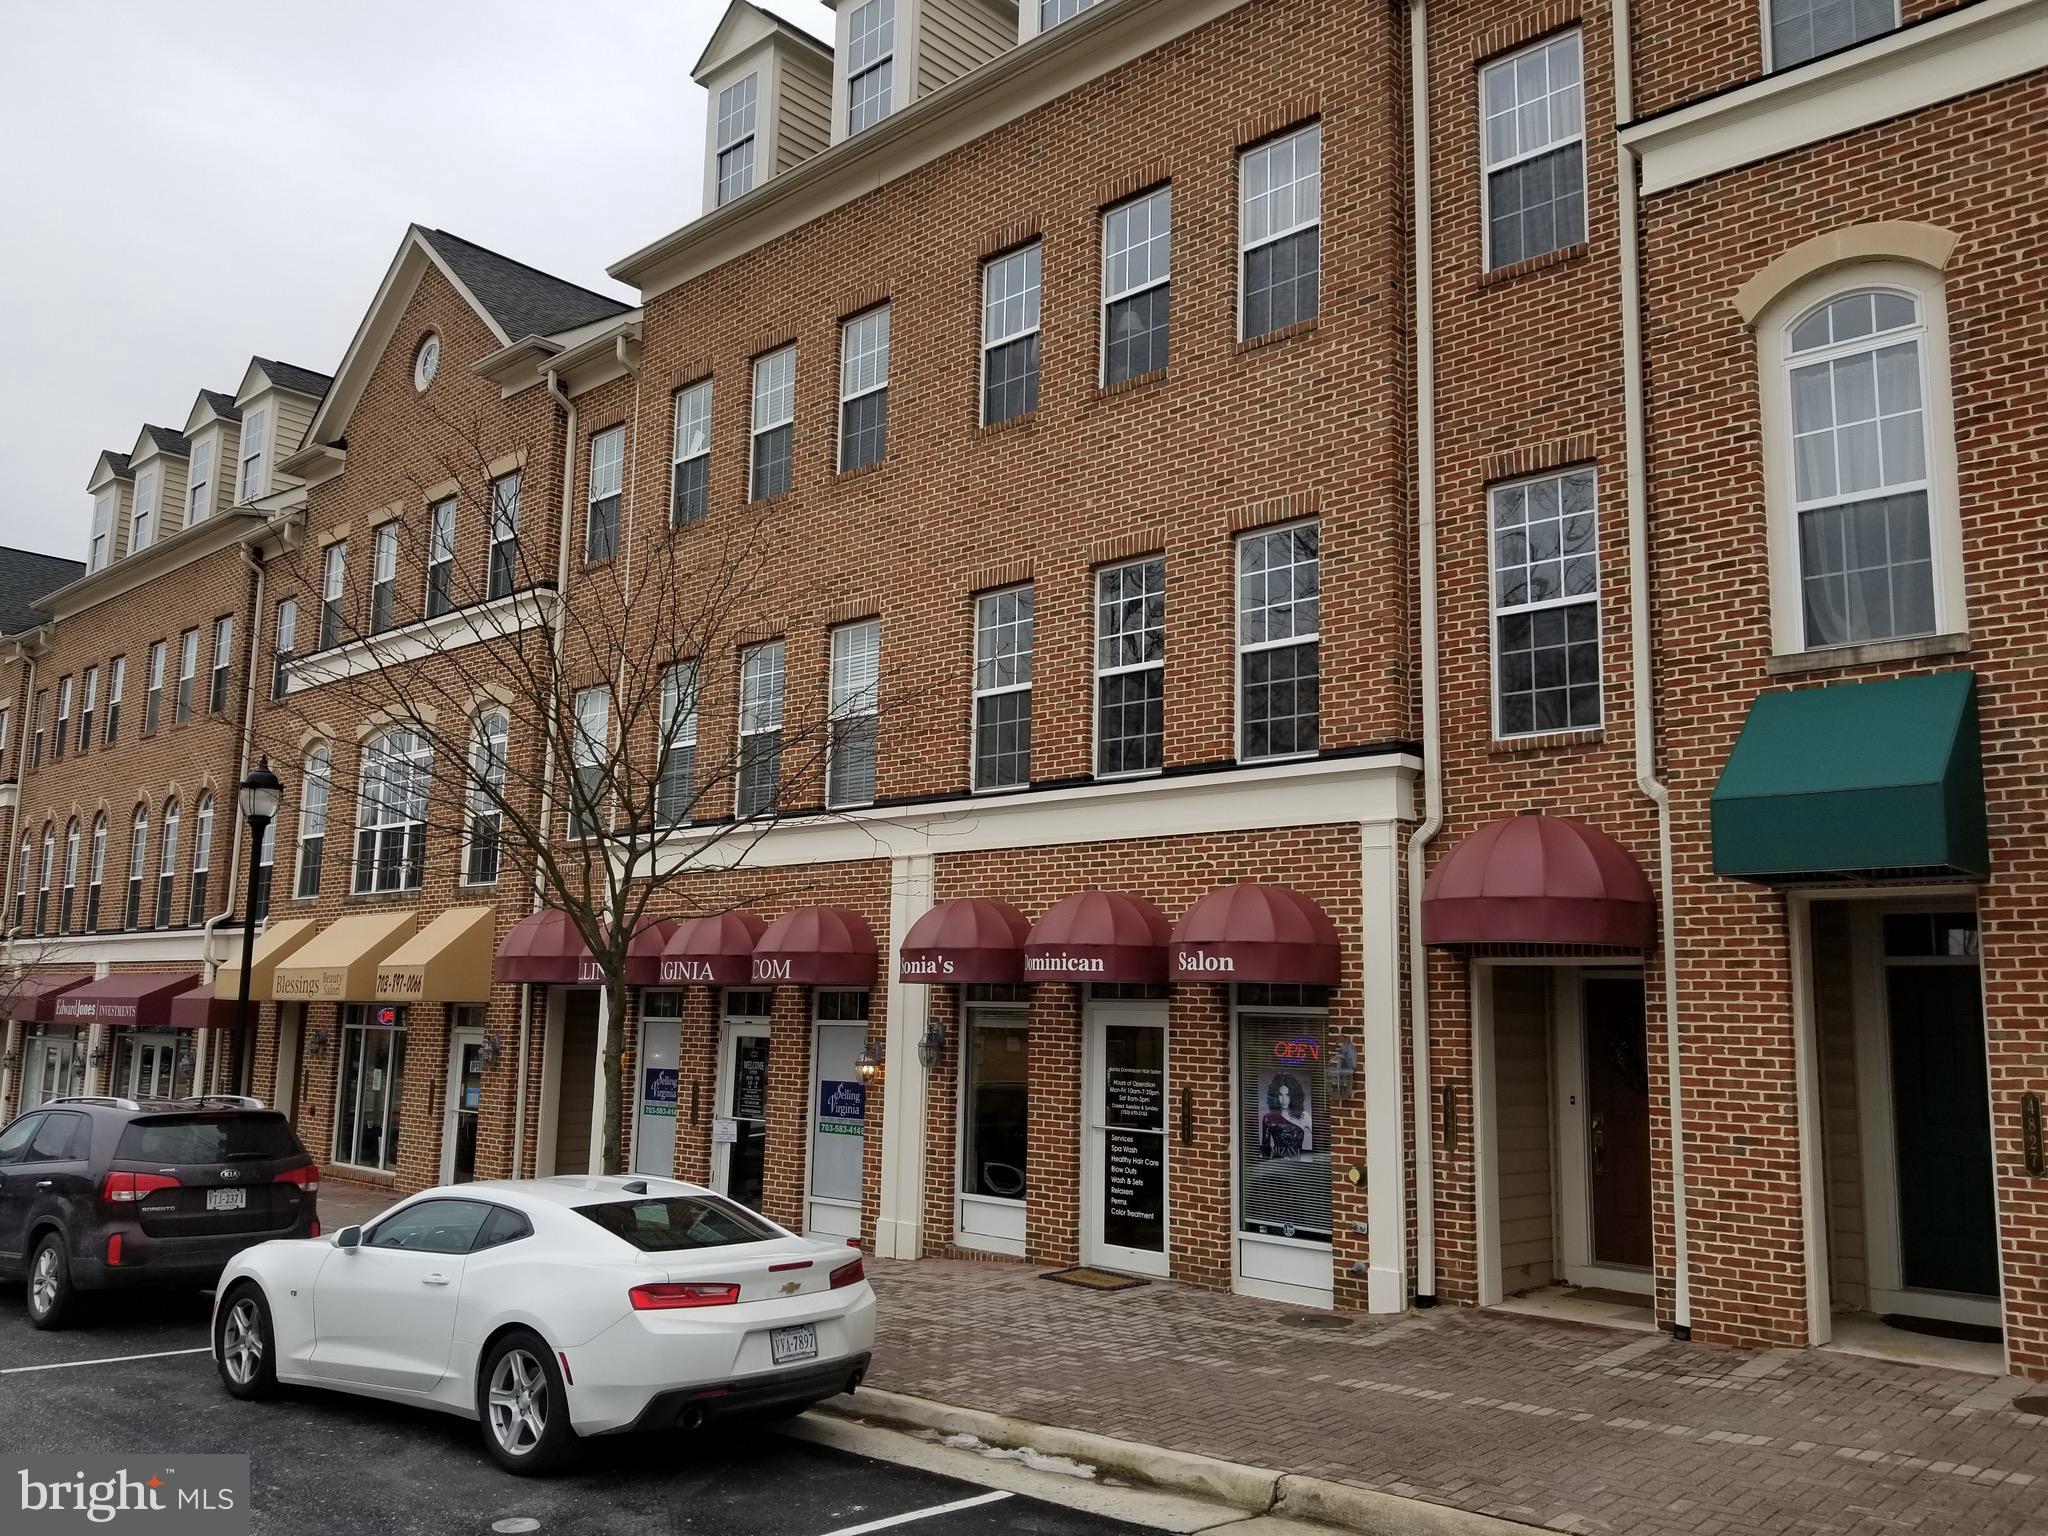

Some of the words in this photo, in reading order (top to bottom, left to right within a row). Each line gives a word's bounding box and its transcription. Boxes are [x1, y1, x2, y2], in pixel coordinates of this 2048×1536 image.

[1178, 950, 1235, 972] Salon
[322, 972, 344, 984] Beauty
[276, 975, 320, 998] Blessings
[323, 984, 341, 996] Salon
[98, 1004, 137, 1017] INVESTMENTS
[1274, 1040, 1320, 1060] OPEN
[650, 1080, 677, 1100] Virginia
[1132, 1080, 1156, 1088] Operation
[833, 1082, 861, 1104] Selling
[827, 1094, 860, 1116] Virginia
[1111, 1134, 1134, 1142] Services
[2027, 1098, 2038, 1167] 4827
[1111, 1144, 1122, 1152] Spa
[1123, 1145, 1138, 1153] Wash
[1111, 1155, 1132, 1164] Healthy
[1132, 1157, 1144, 1165] Hair
[1144, 1158, 1160, 1166] Care
[222, 1170, 239, 1179] KIA
[1111, 1165, 1124, 1173] Blow
[1110, 1175, 1126, 1184] Wash
[1132, 1178, 1144, 1186] Sets
[1111, 1186, 1134, 1195] Relaxers
[1111, 1197, 1127, 1205] Perms
[1110, 1207, 1126, 1216] Color
[1127, 1209, 1154, 1219] Treatment
